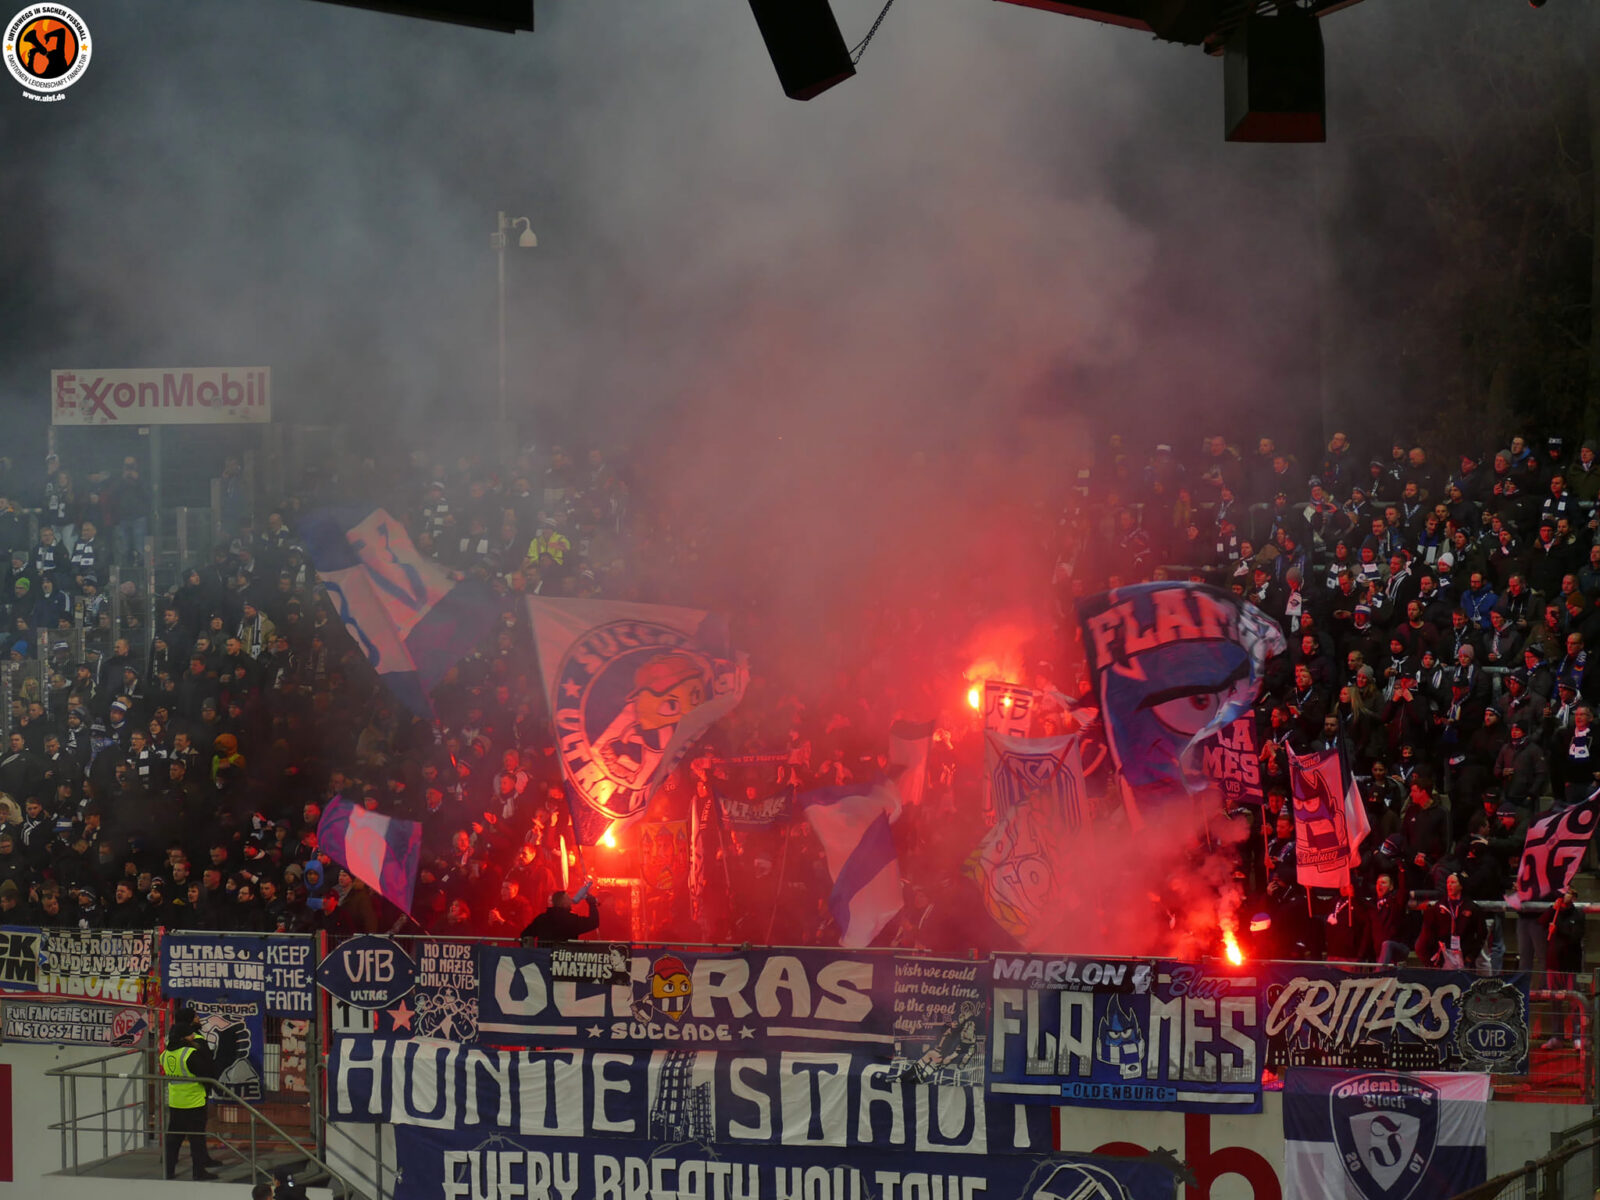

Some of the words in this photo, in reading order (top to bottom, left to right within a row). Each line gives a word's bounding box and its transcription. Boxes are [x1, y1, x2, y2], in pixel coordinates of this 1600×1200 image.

[56, 372, 265, 420] ExxonMobil
[169, 945, 236, 960] ULTRAS
[267, 946, 310, 965] KEEP
[424, 944, 439, 958] NO
[443, 944, 471, 959] COPS
[49, 953, 151, 973] OLDENBURG
[168, 963, 229, 978] SEHEN
[343, 950, 395, 982] VfB
[420, 958, 437, 972] NO
[439, 959, 474, 974] NAZIS
[552, 962, 613, 979] MATHIS
[895, 963, 922, 977] wish
[923, 967, 941, 977] we
[942, 967, 977, 981] could
[993, 959, 1127, 986] MARLON
[168, 978, 221, 988] GESEHEN
[272, 968, 306, 988] THE
[420, 972, 449, 987] ONLY
[452, 975, 475, 990] VfB
[1169, 966, 1231, 999] Blue
[351, 990, 388, 1001] ULTRAS
[894, 981, 919, 993] turn
[920, 982, 949, 996] back
[187, 1001, 257, 1014] OLDENBURG
[265, 991, 312, 1012] FAITH
[894, 999, 905, 1012] to
[906, 998, 925, 1012] the
[926, 1002, 957, 1017] good
[28, 1006, 113, 1024] FANGERECHTE
[1265, 977, 1462, 1049] CRITTERS
[7, 1022, 112, 1041] ANSTOSSZEITEN
[611, 1022, 732, 1041] SUCCADE
[991, 986, 1257, 1083] FLAMES
[1478, 1029, 1506, 1047] VfB
[337, 1038, 636, 1132] HUNTE
[1338, 1079, 1433, 1105] Oldenburg
[1362, 1094, 1406, 1109] Block
[1345, 1151, 1361, 1172] 20
[1409, 1153, 1425, 1174] 07
